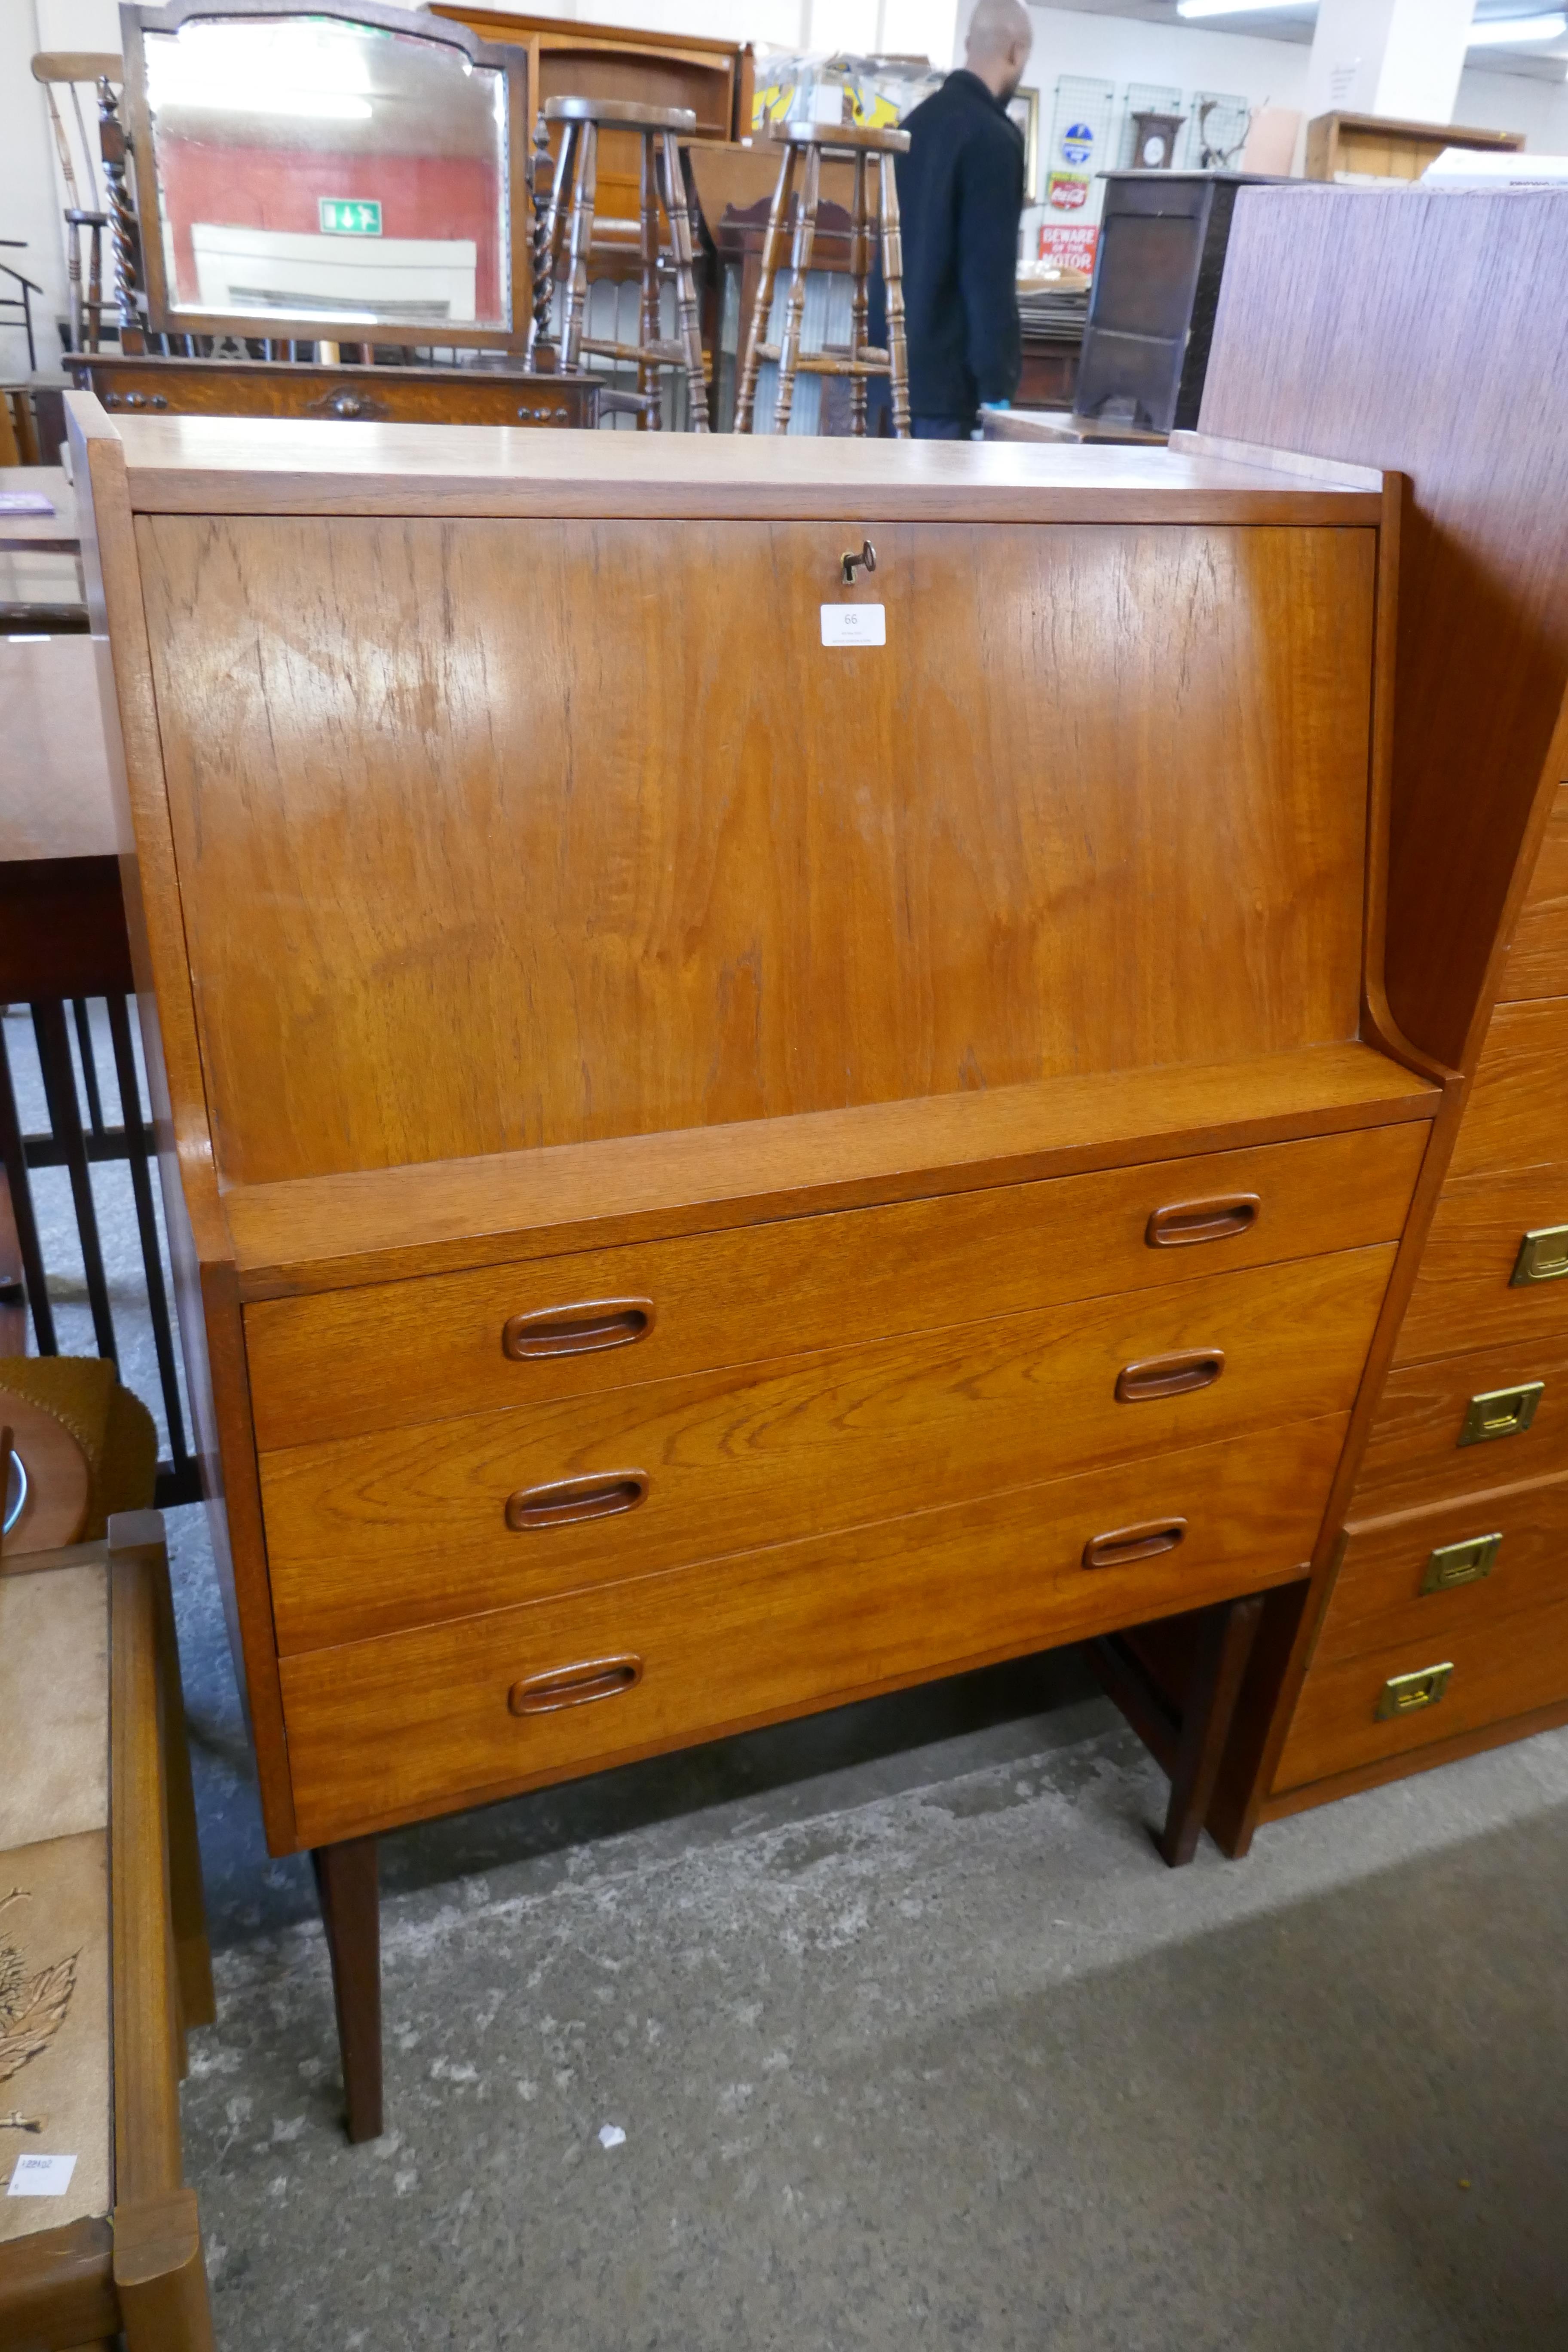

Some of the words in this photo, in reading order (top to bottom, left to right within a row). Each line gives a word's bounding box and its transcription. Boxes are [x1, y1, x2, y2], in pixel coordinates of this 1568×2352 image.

[1043, 228, 1095, 244] BEWARE
[1042, 252, 1091, 269] MOTOR
[845, 614, 858, 624] 66
